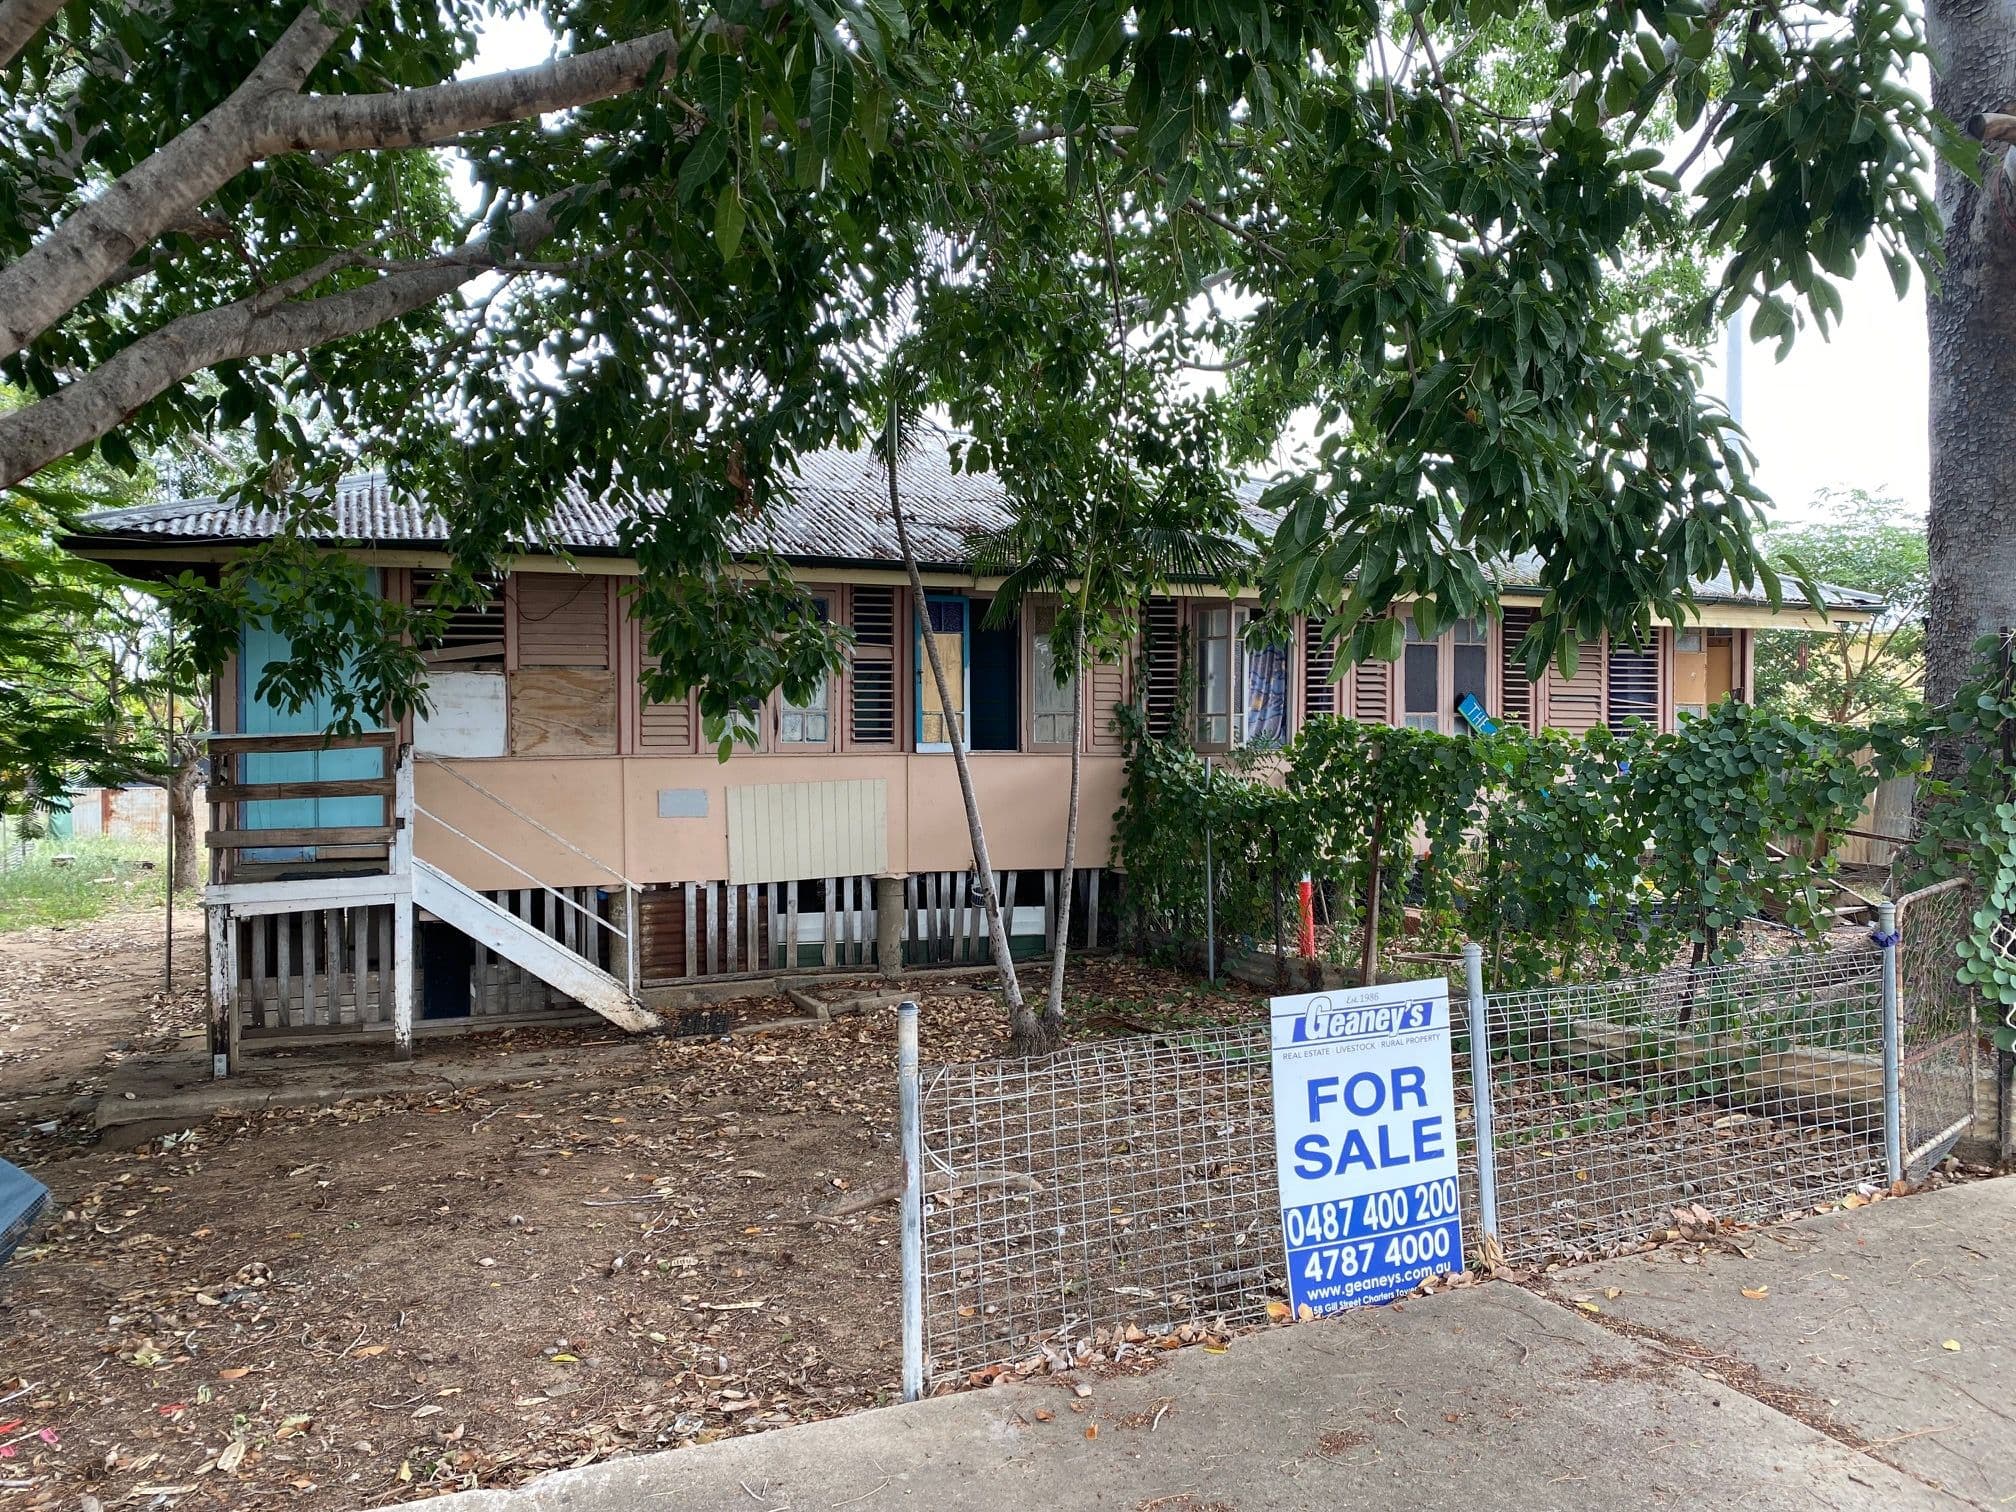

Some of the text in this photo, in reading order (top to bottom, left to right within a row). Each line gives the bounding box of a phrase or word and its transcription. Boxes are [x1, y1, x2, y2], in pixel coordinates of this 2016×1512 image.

[1304, 995, 1425, 1041] Geaney's
[1282, 1033, 1441, 1061] REAL ESTATE LIVESTOCK RURAL PROPERTY
[1307, 1066, 1428, 1124] FOR
[1293, 1115, 1445, 1181] SALE
[1287, 1178, 1456, 1247] 0487 400 200
[1304, 1227, 1450, 1282] 4787 4000
[1306, 1261, 1451, 1301] www.geaneys.com.au
[1325, 1301, 1338, 1313] Gill
[1339, 1297, 1362, 1309] Street
[1362, 1292, 1395, 1305] Charters
